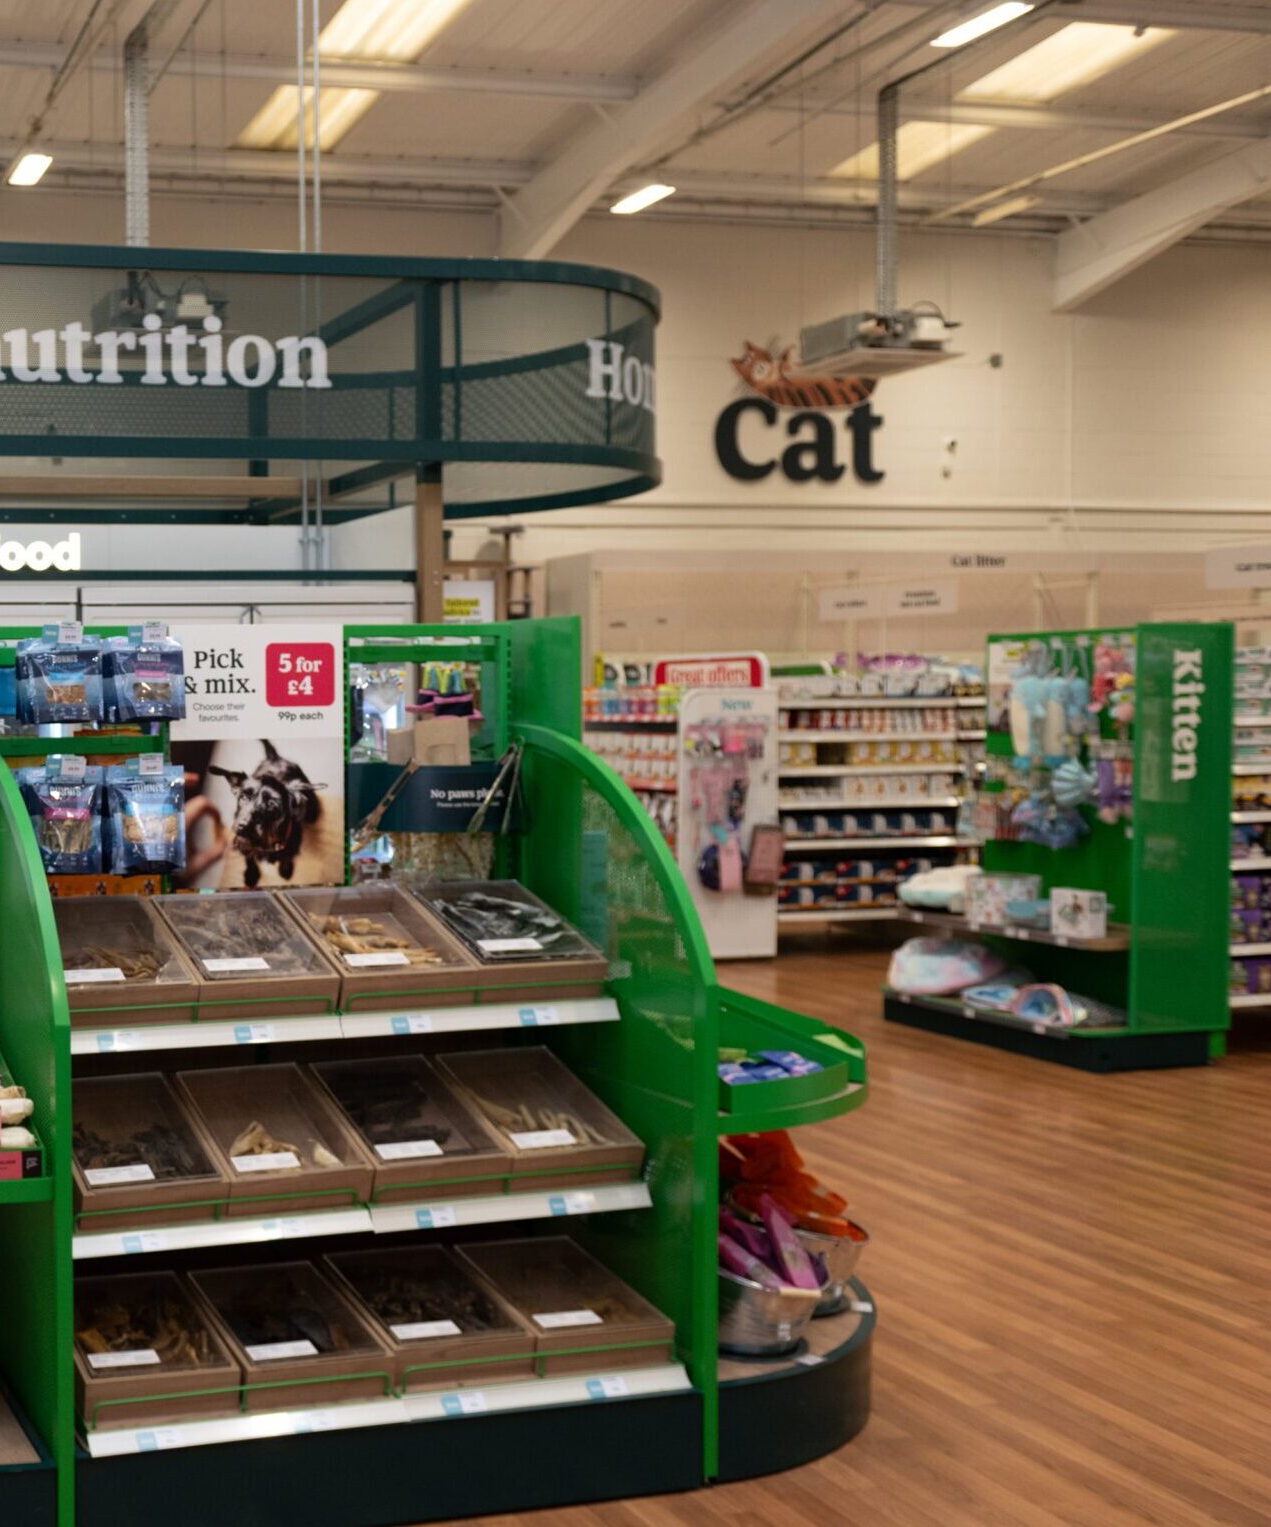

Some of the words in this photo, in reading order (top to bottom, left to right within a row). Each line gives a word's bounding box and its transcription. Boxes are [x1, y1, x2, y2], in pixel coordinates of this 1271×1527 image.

[714, 396, 886, 483] Cat
[194, 648, 244, 669] Pick
[278, 653, 293, 673] 5
[296, 656, 323, 673] for
[184, 676, 198, 694] &
[205, 674, 256, 694] mix.
[287, 676, 314, 696] £4
[193, 702, 225, 711] Choose
[227, 702, 246, 711] their
[721, 698, 753, 711] New
[278, 711, 298, 722] 99p
[300, 711, 325, 721] each
[1171, 649, 1206, 782] Kitten
[430, 789, 446, 799] No
[447, 790, 475, 801] paws
